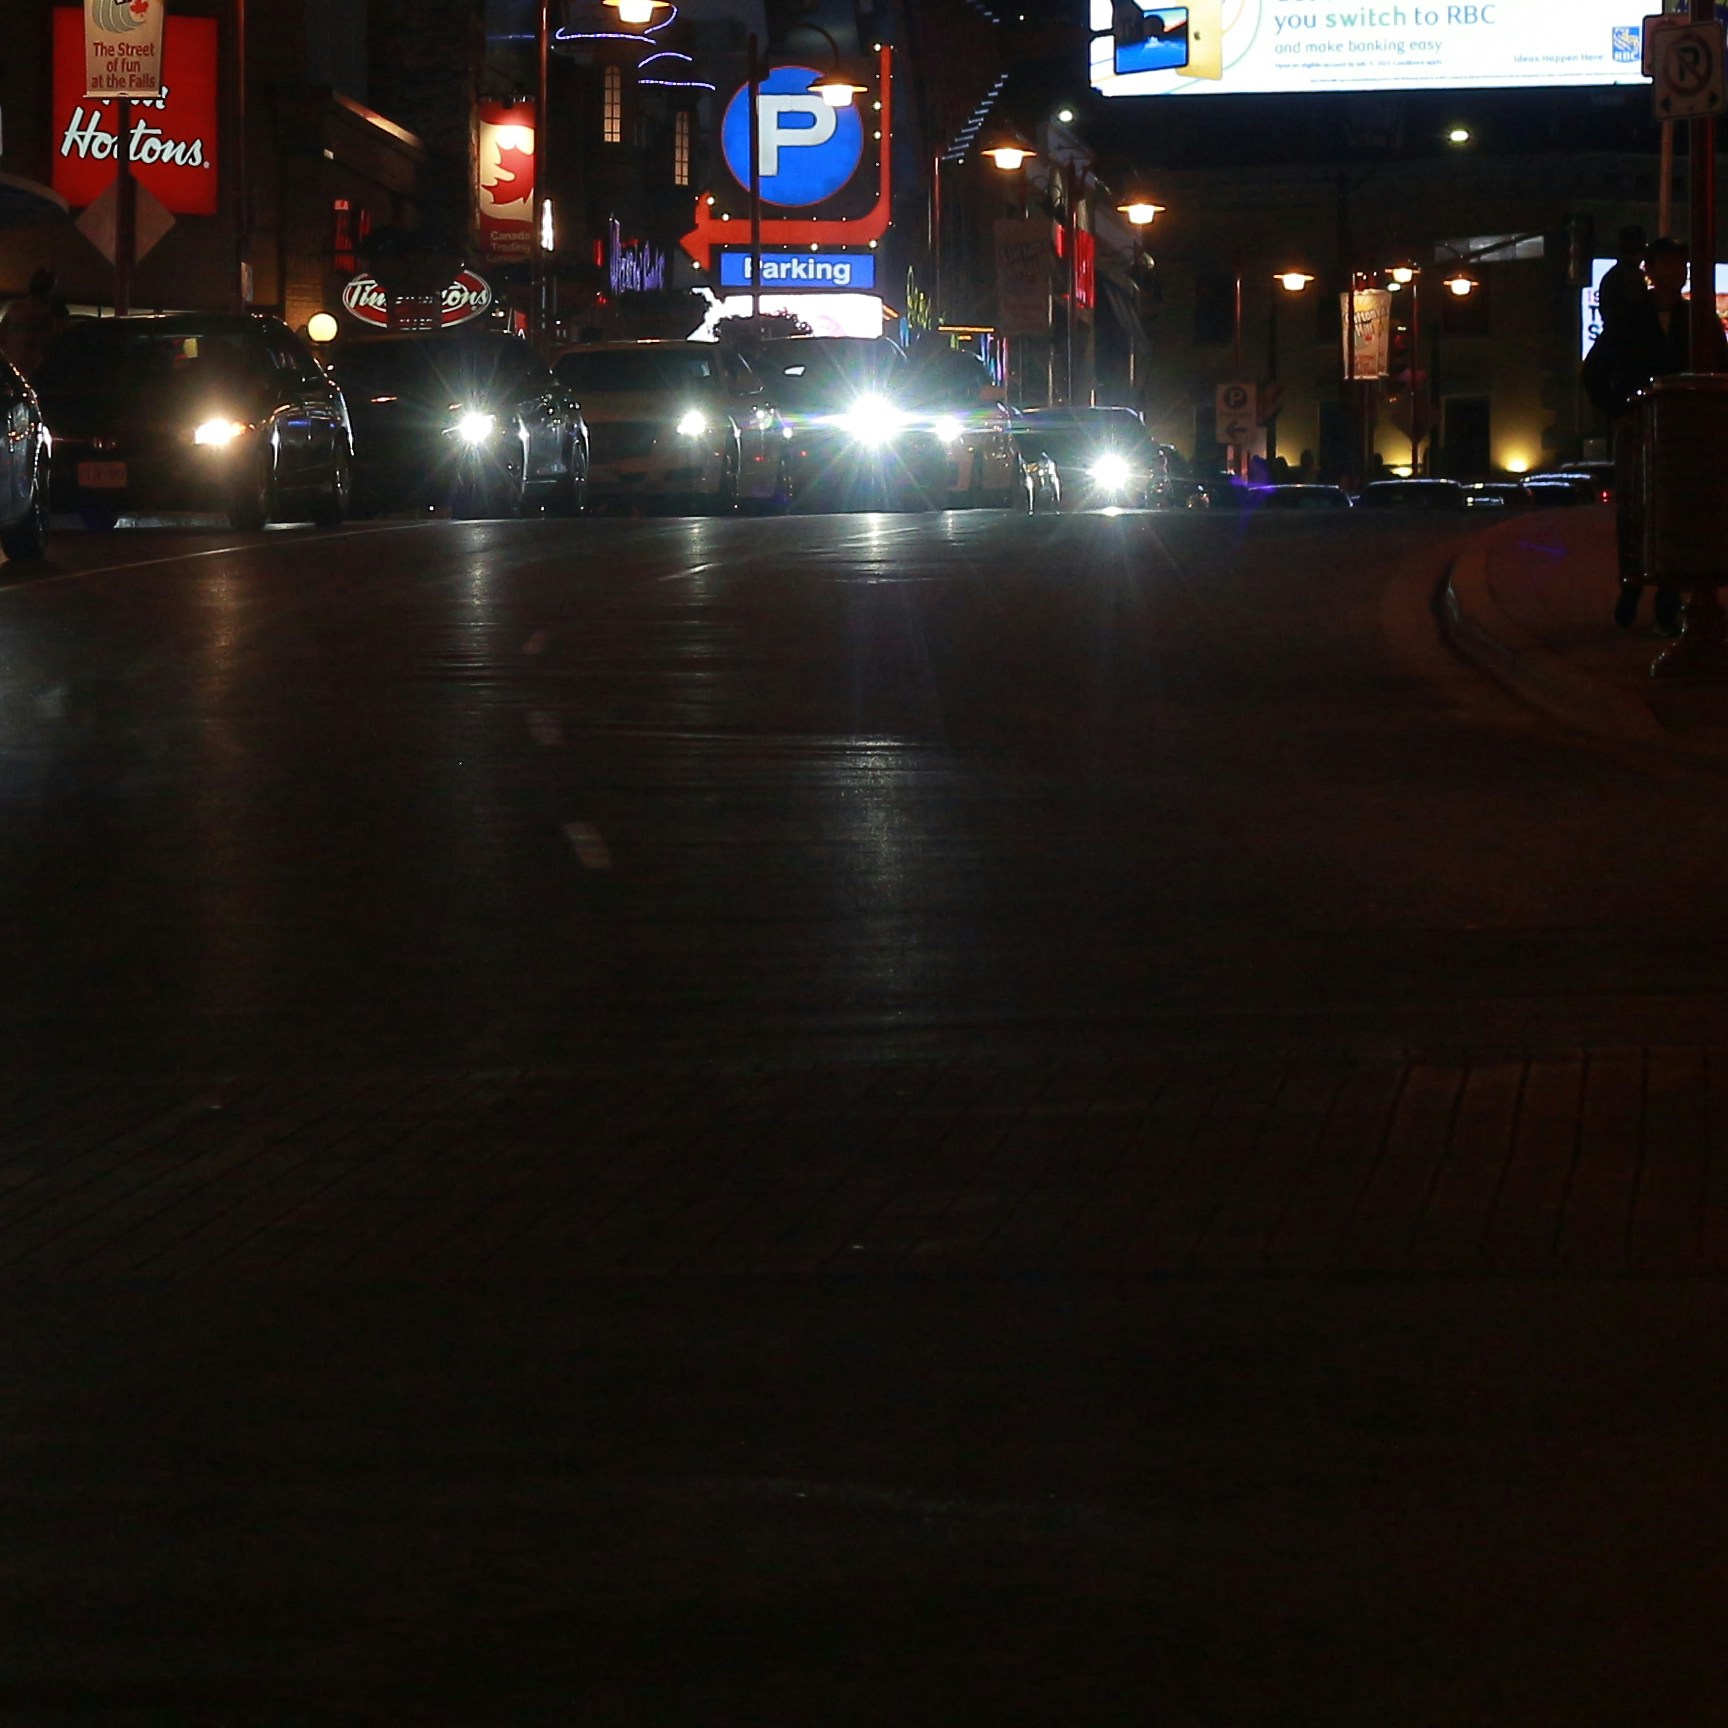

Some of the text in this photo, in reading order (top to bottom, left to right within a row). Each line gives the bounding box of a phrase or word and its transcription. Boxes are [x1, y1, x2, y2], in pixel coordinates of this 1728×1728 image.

[1273, 3, 1498, 37] you switch to RBC
[93, 41, 155, 58] The Street
[1274, 36, 1444, 57] and make banking easy
[1513, 54, 1540, 63] Ideas
[1581, 53, 1604, 62] Here
[1614, 51, 1640, 62] RBC
[106, 57, 141, 73] of fun
[91, 73, 156, 89] at the Falls
